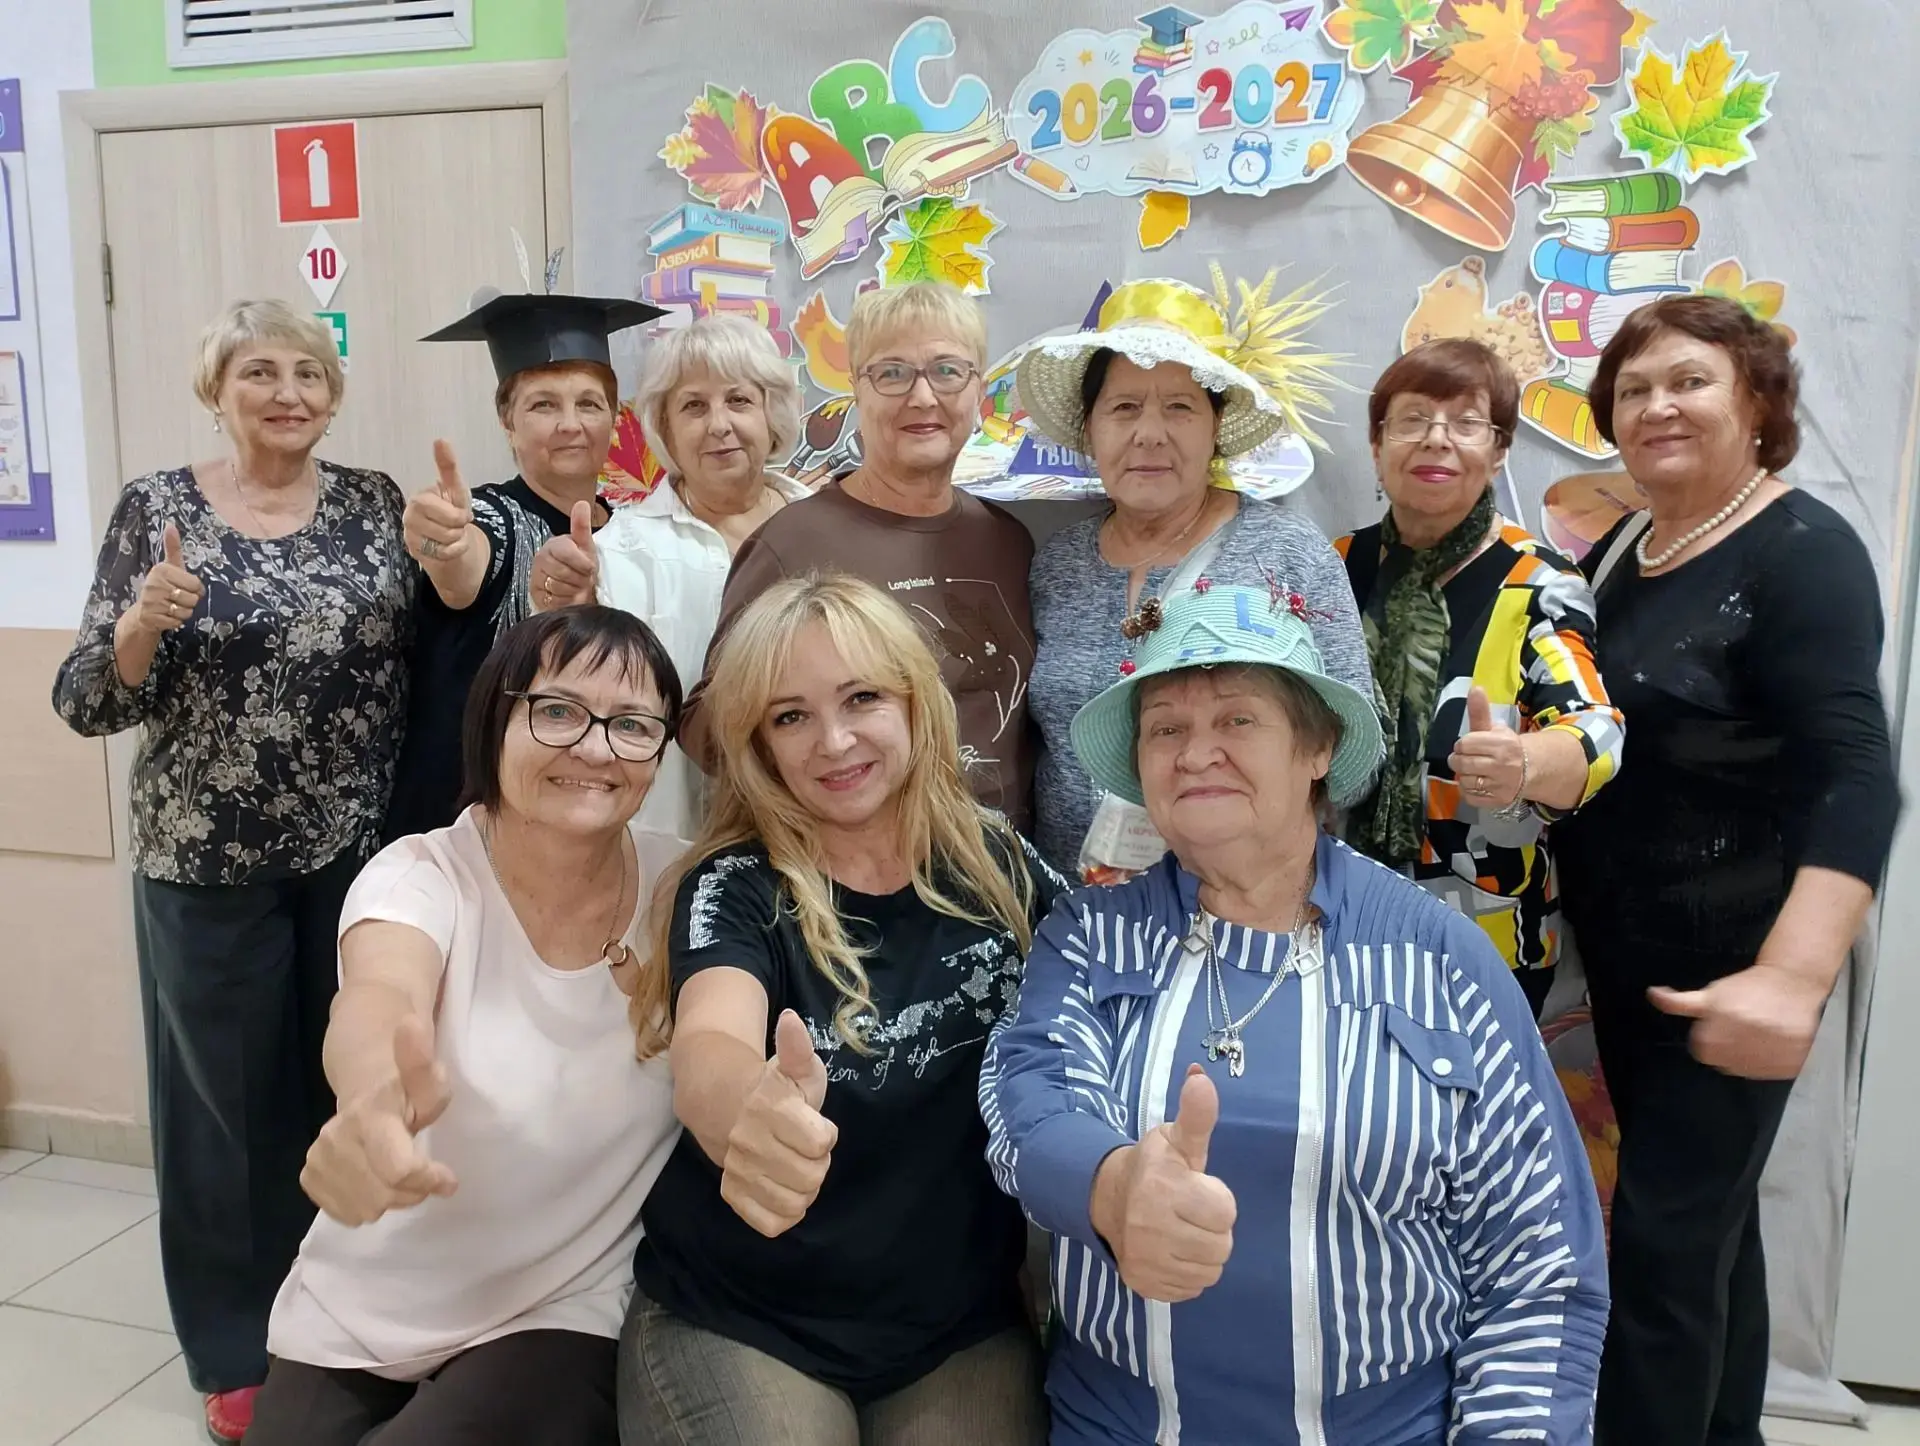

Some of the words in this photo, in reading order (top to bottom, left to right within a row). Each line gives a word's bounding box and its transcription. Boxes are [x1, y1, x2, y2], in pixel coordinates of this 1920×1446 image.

[1027, 60, 1343, 150] 2026-2027
[762, 17, 989, 238] ABC
[730, 217, 780, 236] Пушкин
[306, 247, 337, 280] 10
[659, 244, 709, 270] АЗБУКА
[887, 579, 911, 591] Long
[909, 575, 935, 588] Island
[870, 1046, 895, 1091] of
